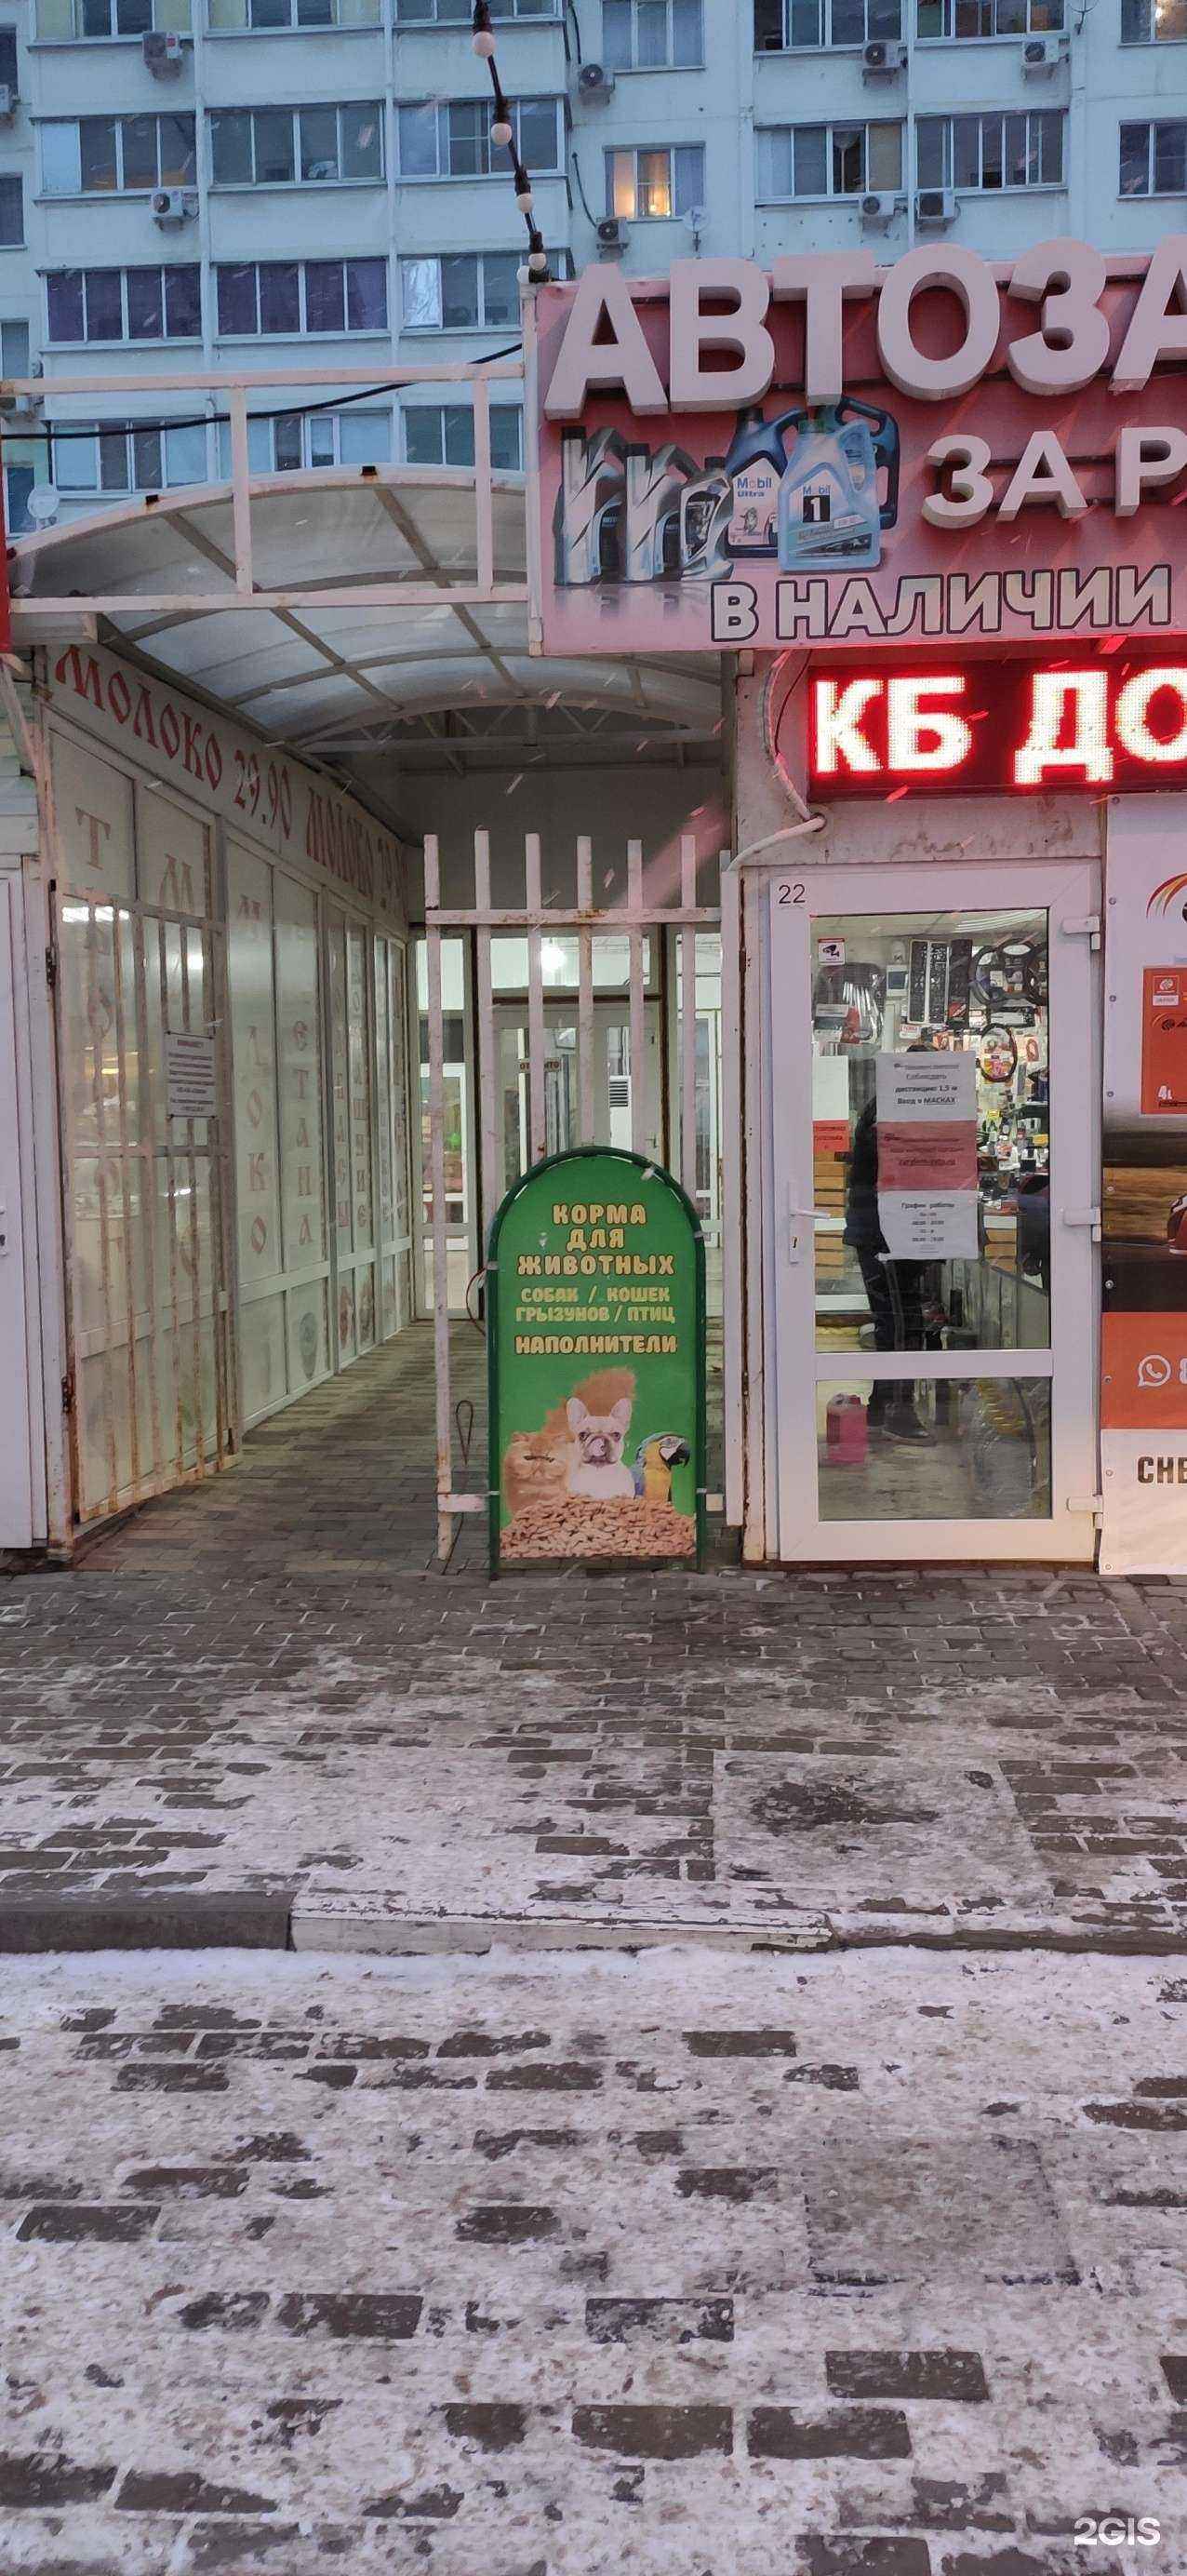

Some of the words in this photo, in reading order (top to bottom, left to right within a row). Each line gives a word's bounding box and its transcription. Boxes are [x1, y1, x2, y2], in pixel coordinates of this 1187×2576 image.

[737, 476, 772, 489] Mobil
[803, 484, 831, 495] Mbil
[921, 431, 1089, 529] ЗА
[711, 581, 759, 641] В
[774, 564, 1172, 640] НАЛИЧИИ
[814, 678, 972, 773] КБ
[1012, 668, 1187, 785] ДО
[55, 644, 223, 792] МОЛОКО
[233, 749, 293, 839] 29.90
[778, 883, 806, 904] 22
[236, 894, 270, 1255] МЛОКО
[290, 935, 314, 1247] ЕТАНА
[553, 1204, 647, 1224] КОРМА
[566, 1228, 625, 1252] ДЛЯ
[517, 1254, 674, 1275] ЖИВОТНЫХ
[521, 1286, 578, 1302] СОБАК
[588, 1285, 597, 1303] /
[607, 1286, 670, 1302] КОШЕК
[516, 1307, 609, 1322] ГРЫЗУНОВ
[627, 1305, 675, 1323] ПТИЦ
[515, 1333, 678, 1355] НАПОЛНИТЕЛИ
